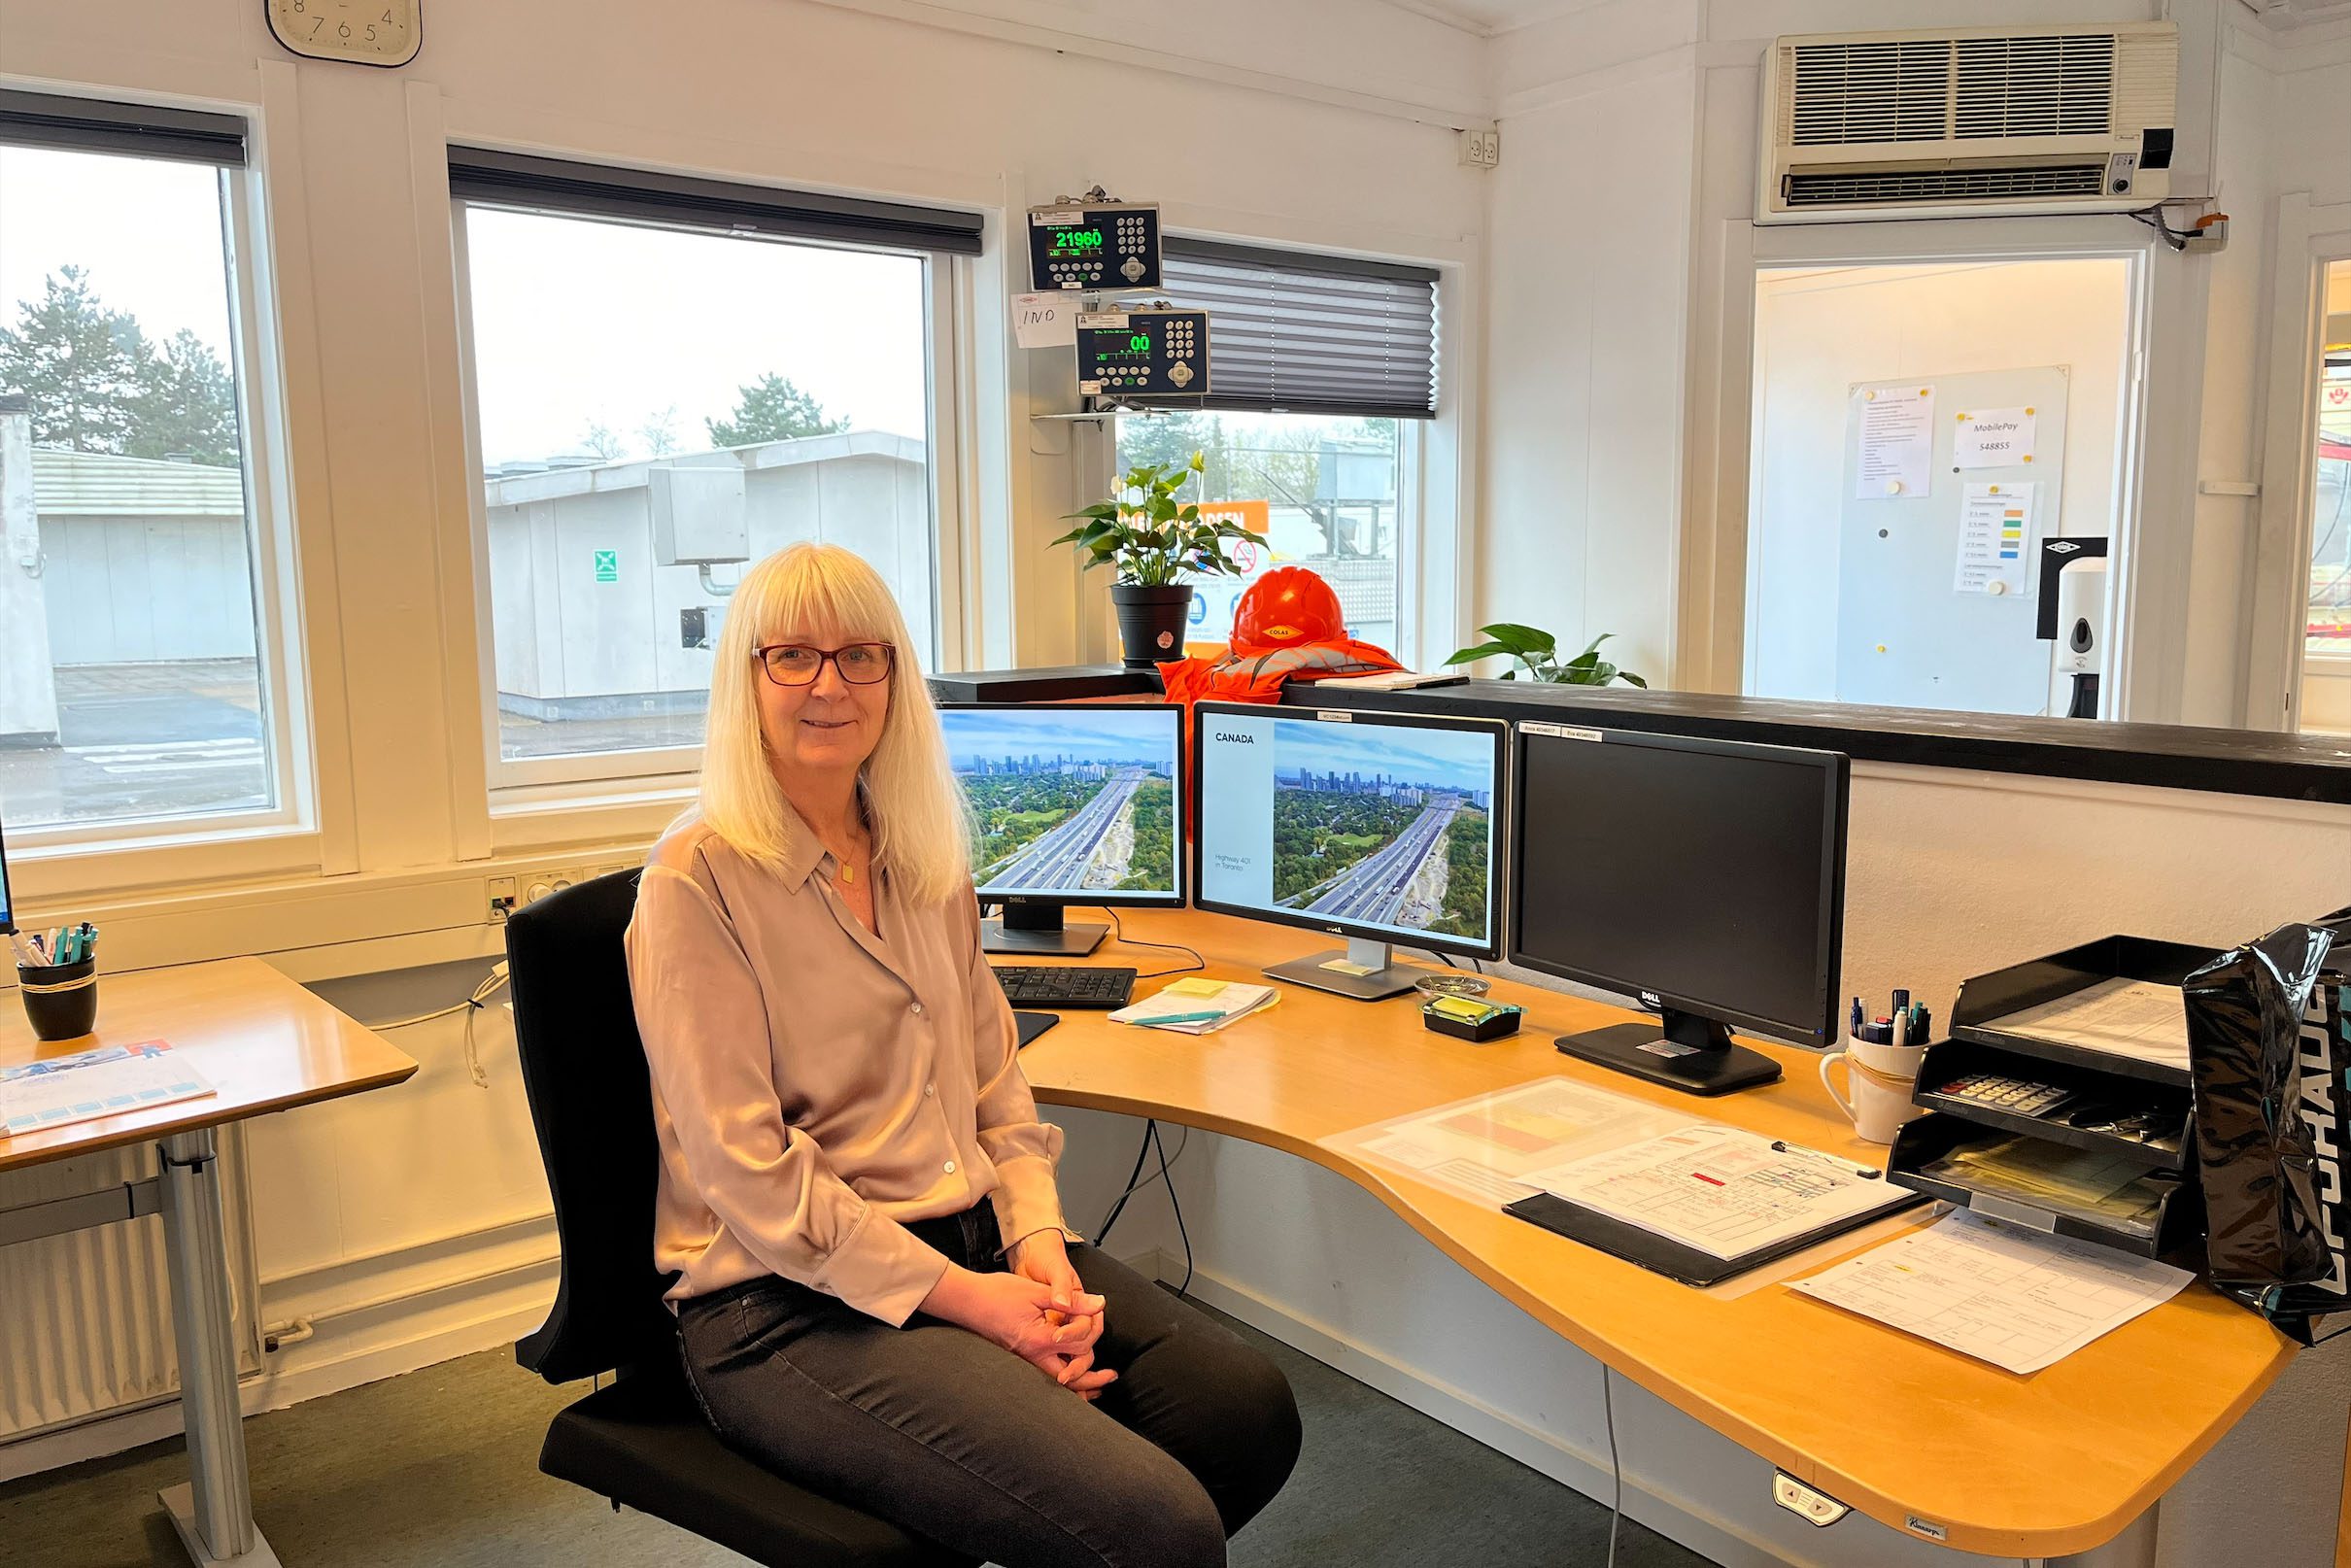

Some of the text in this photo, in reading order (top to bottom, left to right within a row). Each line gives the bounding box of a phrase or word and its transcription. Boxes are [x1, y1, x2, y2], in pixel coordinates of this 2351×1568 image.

[381, 9, 392, 25] 4
[312, 17, 324, 34] 7
[338, 21, 351, 38] 6
[365, 24, 376, 42] 5
[1056, 231, 1103, 247] 21960
[1130, 335, 1150, 351] 00
[1974, 423, 2019, 432] MobilePay
[1979, 441, 2011, 451] 548855
[1215, 733, 1254, 744] CANADA
[1214, 854, 1241, 864] Highway
[1222, 862, 1244, 871] Toronto
[1641, 990, 1661, 1003] DELL
